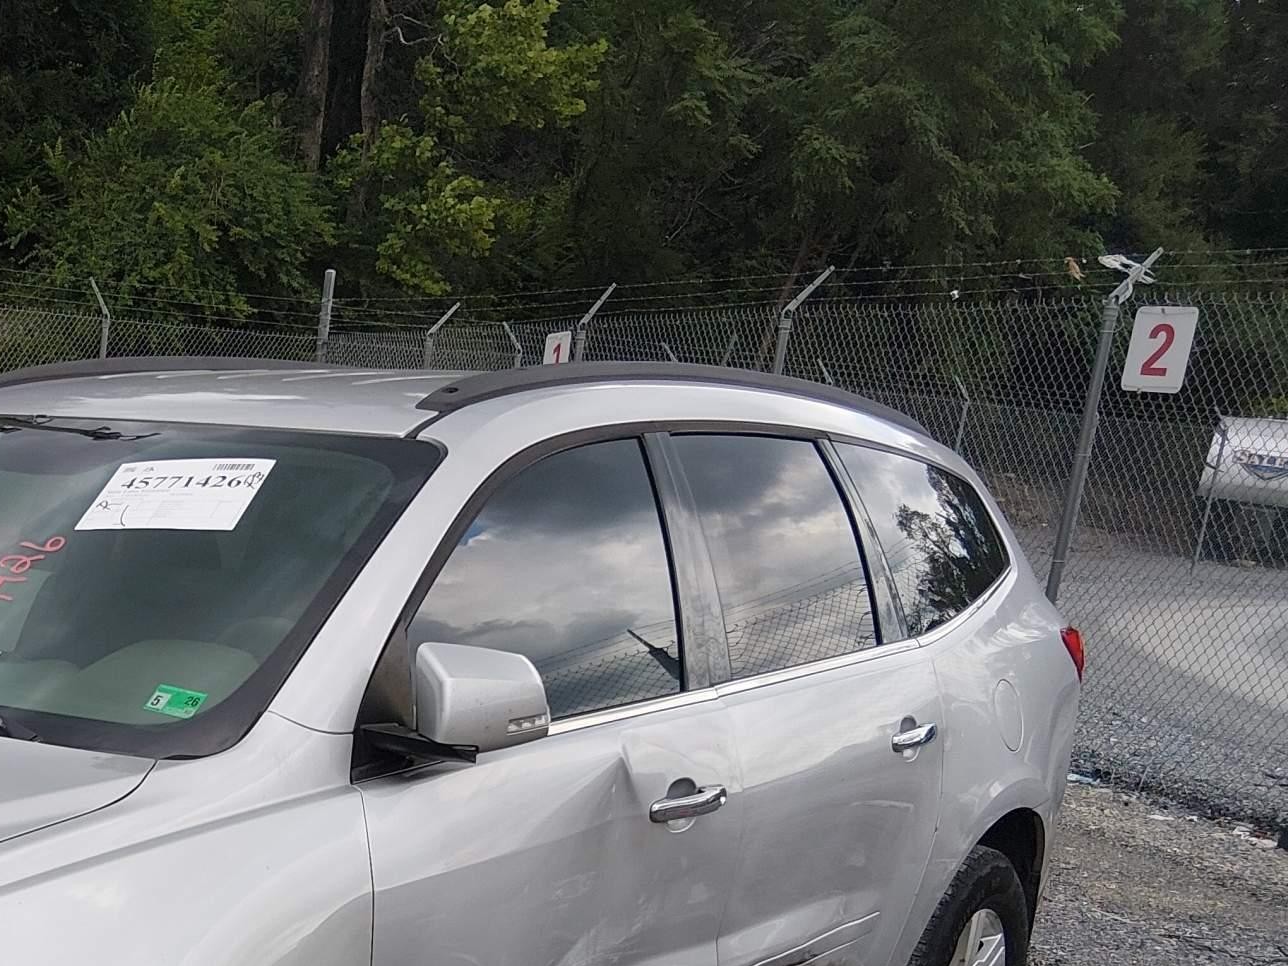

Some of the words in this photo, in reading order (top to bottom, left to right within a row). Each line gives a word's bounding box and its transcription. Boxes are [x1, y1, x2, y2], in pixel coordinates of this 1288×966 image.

[552, 341, 562, 364] 1
[1139, 323, 1176, 377] 2
[120, 474, 242, 490] 45771426
[150, 694, 163, 707] 5
[183, 695, 201, 707] 26
